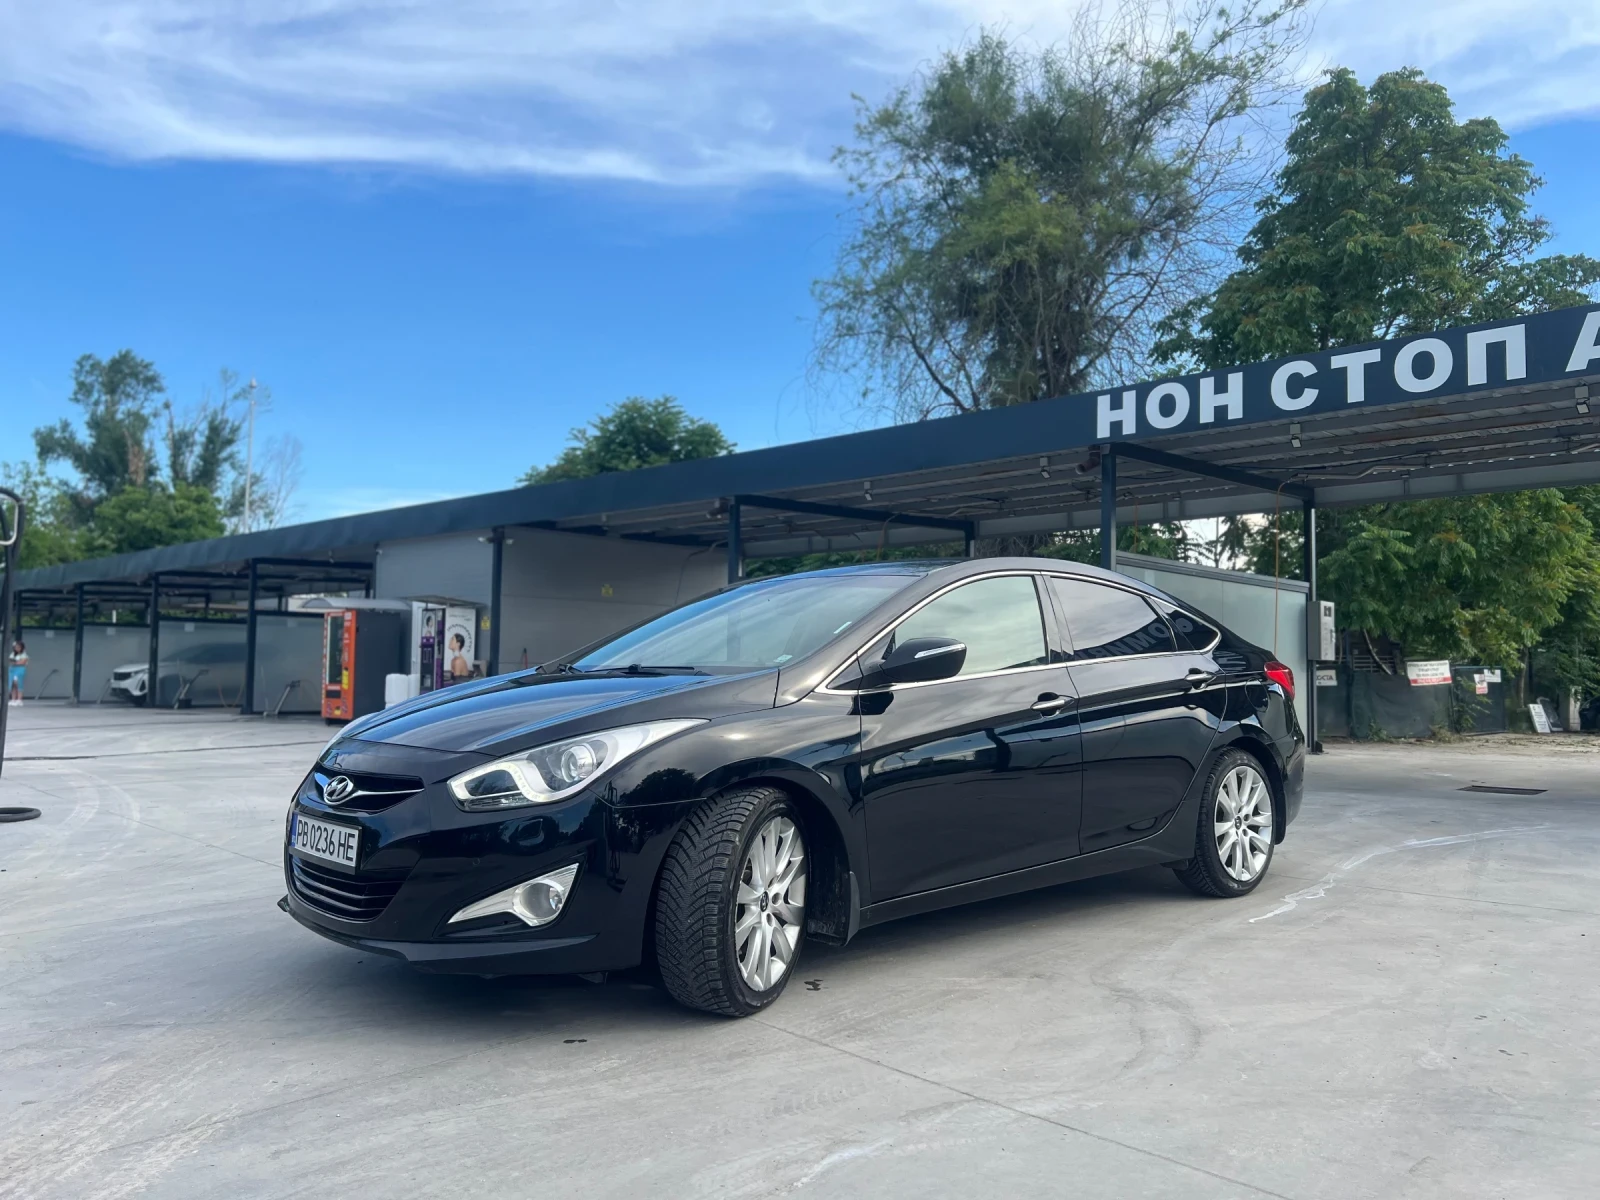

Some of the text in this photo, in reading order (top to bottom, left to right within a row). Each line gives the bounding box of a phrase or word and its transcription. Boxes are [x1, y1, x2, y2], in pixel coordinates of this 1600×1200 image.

[1096, 371, 1244, 439] НОН
[1270, 323, 1527, 411] СТОП
[296, 819, 356, 862] PB 0236 HE
